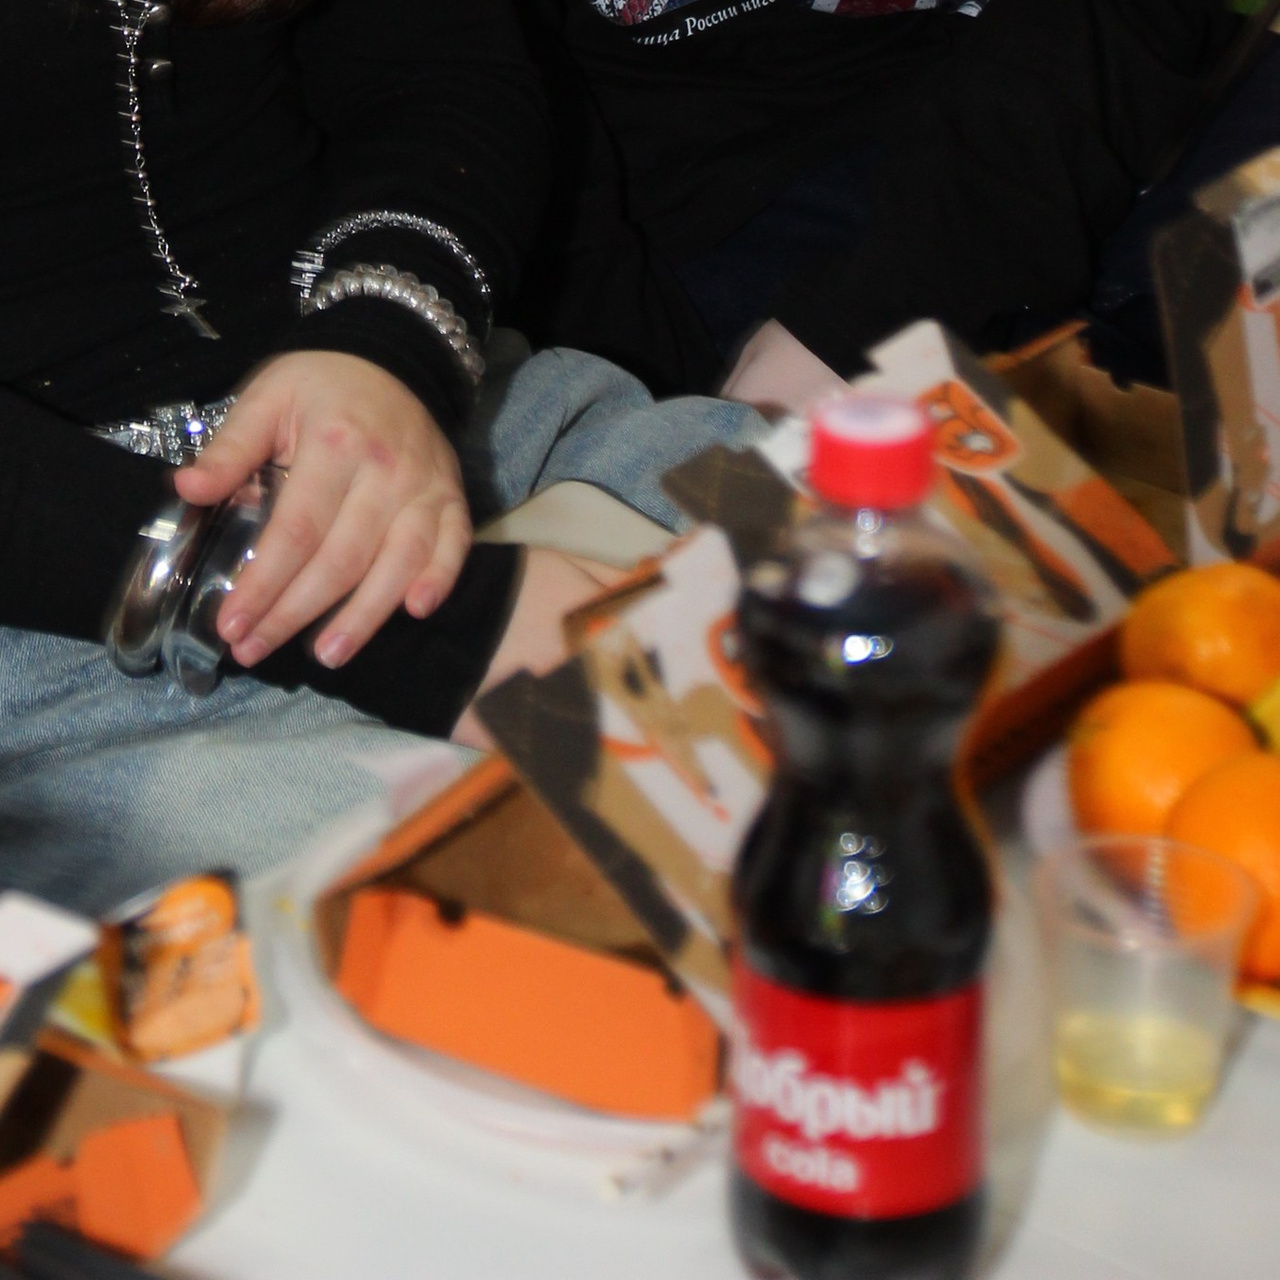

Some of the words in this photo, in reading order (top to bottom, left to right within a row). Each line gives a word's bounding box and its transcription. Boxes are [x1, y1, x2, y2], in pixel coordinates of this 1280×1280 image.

[634, 28, 680, 46] ица
[685, 6, 738, 36] России
[736, 1049, 940, 1139] обрый
[763, 1135, 858, 1192] cola
